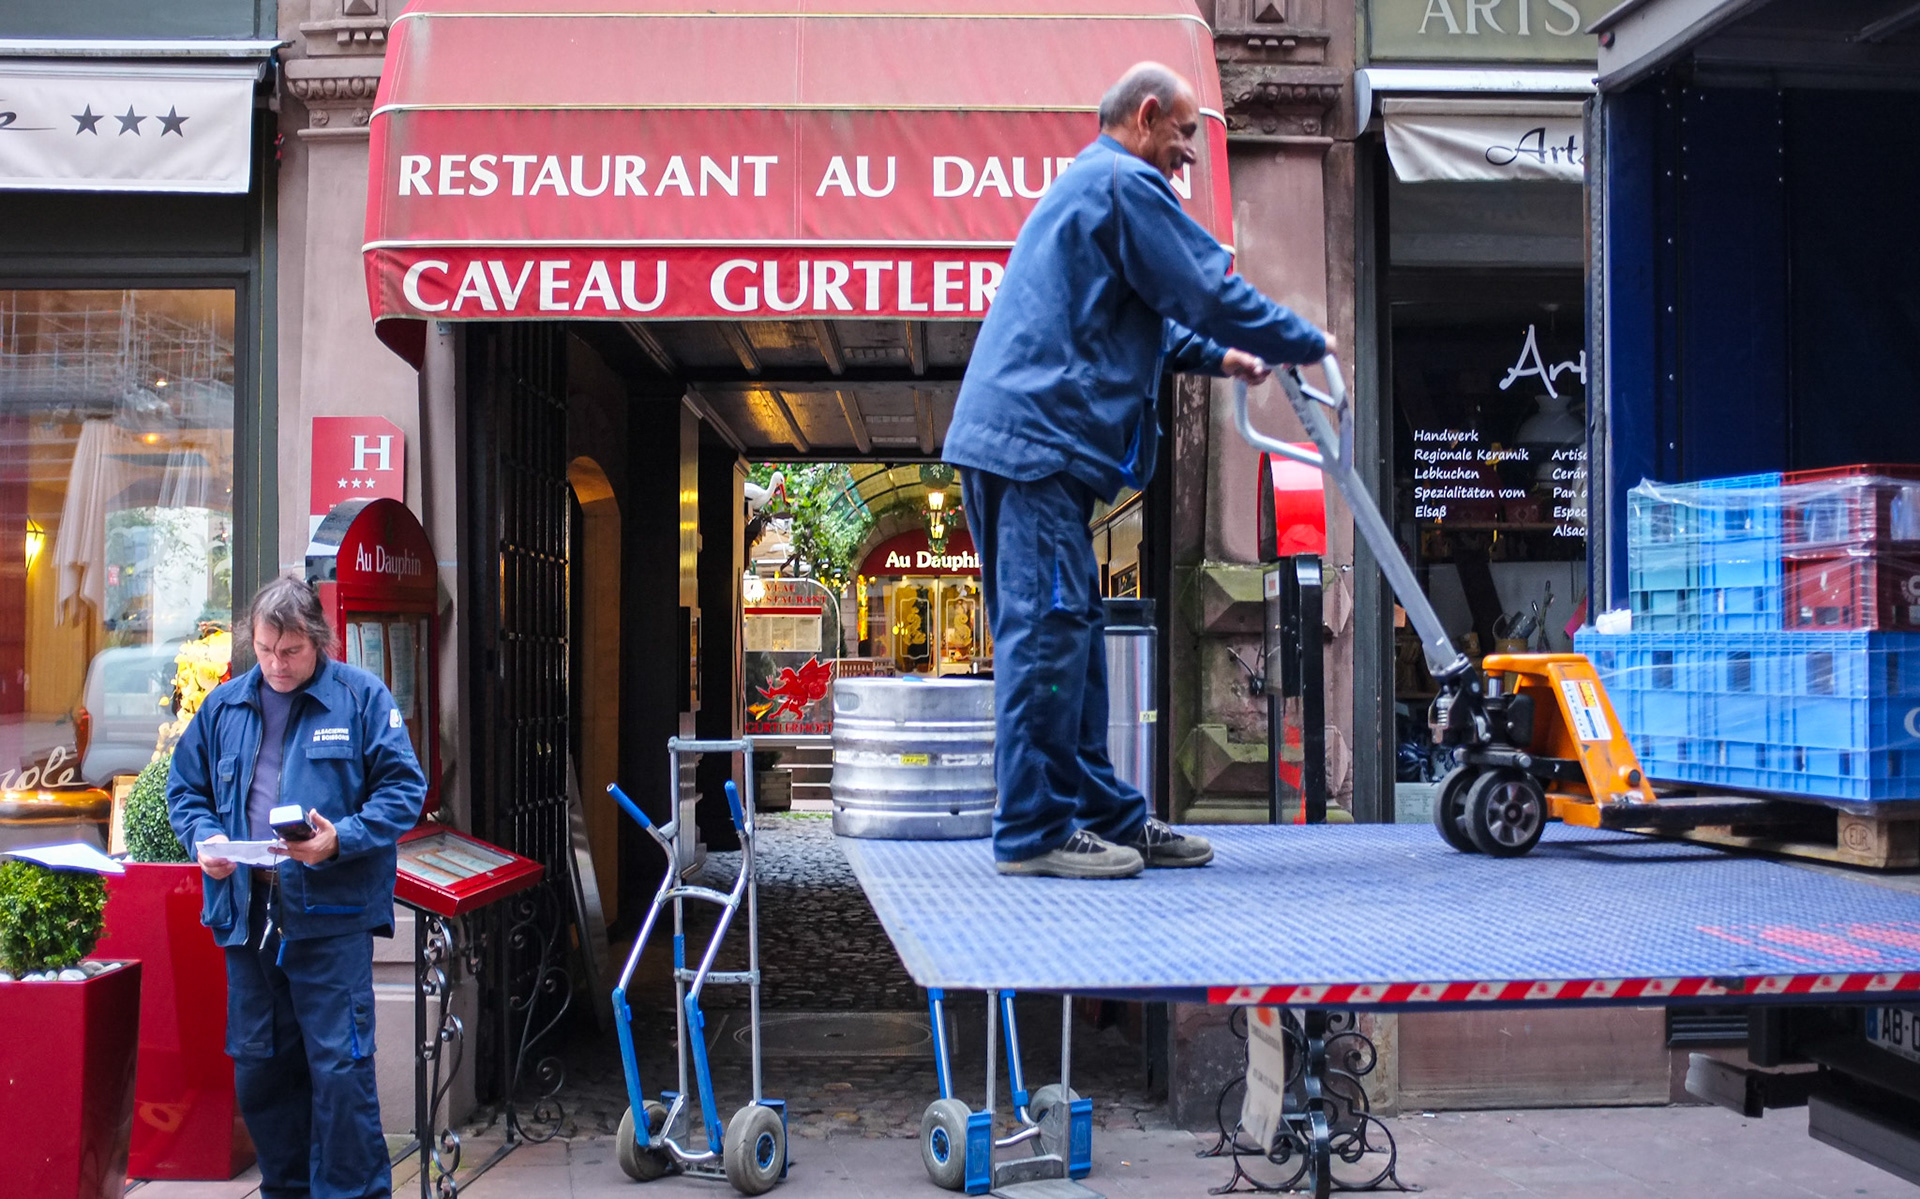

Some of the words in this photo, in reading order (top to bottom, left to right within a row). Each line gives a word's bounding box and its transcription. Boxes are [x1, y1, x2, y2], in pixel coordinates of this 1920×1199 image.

[398, 154, 778, 197] RESTAURANT
[815, 155, 897, 198] AU
[933, 156, 1192, 199] DAUN
[402, 258, 668, 312] CAVEAU
[1413, 429, 1479, 442] Handwerk
[350, 434, 394, 471] H
[1414, 448, 1473, 464] Regionale
[1476, 448, 1529, 461] Keramik
[1414, 466, 1480, 480] Lebkuchen
[1414, 485, 1495, 502] Spezialitäten
[1498, 489, 1526, 499] vom
[1552, 487, 1577, 499] Pan
[1415, 505, 1447, 520] Elsaß
[355, 542, 372, 572] Au
[376, 545, 421, 581] Dauphin
[885, 550, 911, 568] Au
[916, 550, 983, 572] Dauphi
